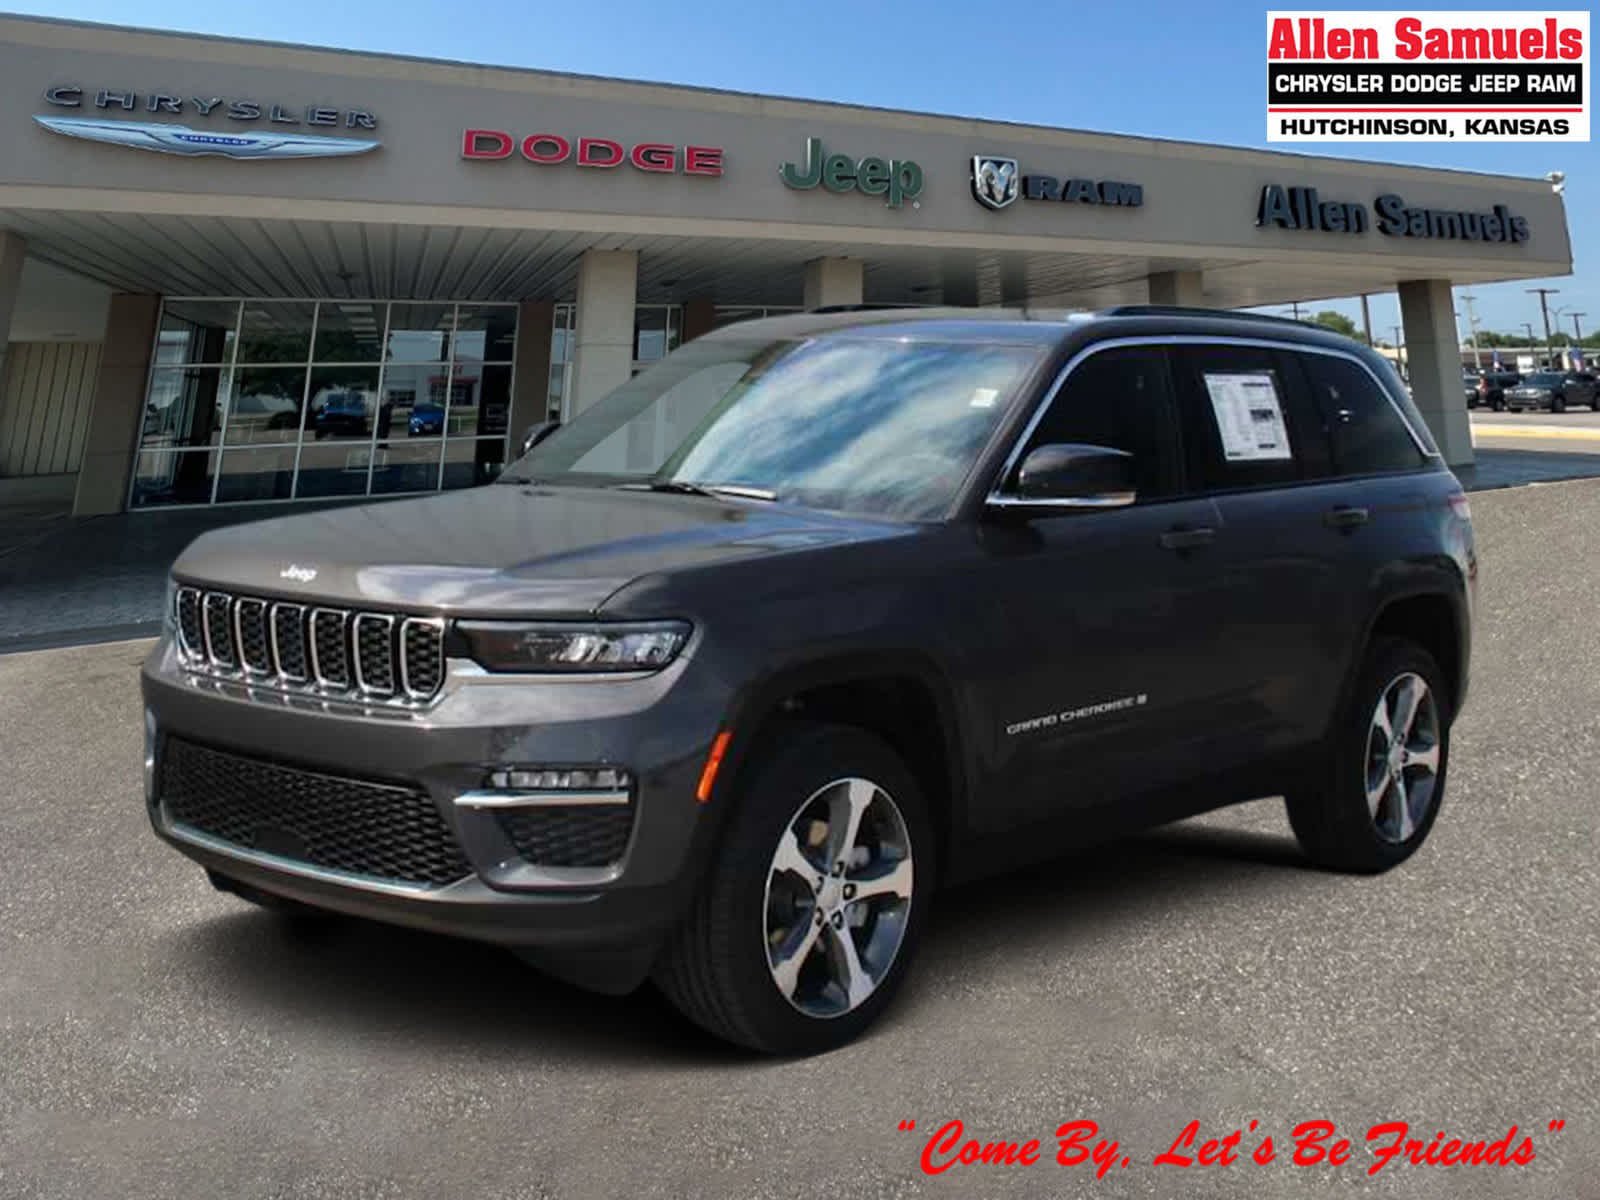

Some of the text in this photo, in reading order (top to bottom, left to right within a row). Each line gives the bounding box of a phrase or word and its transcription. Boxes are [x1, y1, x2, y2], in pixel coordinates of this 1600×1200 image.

[44, 86, 378, 129] CHRYSLER
[461, 128, 725, 176] DODGE
[778, 136, 924, 210] Jeep
[1021, 174, 1144, 207] RAM
[1256, 183, 1530, 244] Allen Samuels
